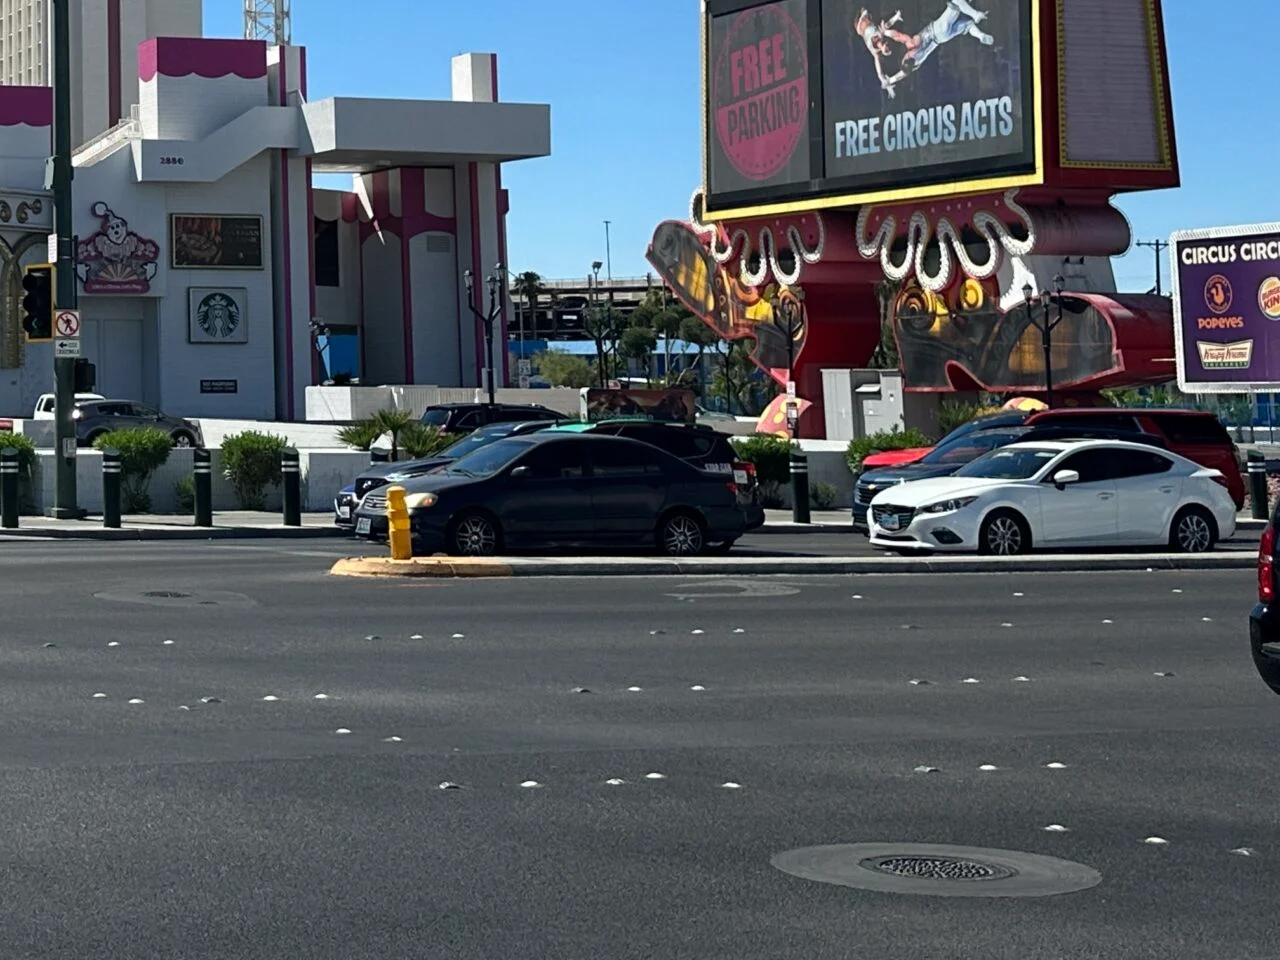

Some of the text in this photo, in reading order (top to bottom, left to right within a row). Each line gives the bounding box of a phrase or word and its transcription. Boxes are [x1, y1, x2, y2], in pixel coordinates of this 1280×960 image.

[730, 32, 786, 98] FREE
[727, 85, 800, 147] PARKING
[835, 96, 1013, 158] FREE CIRCUS ACTS
[1181, 244, 1237, 265] CIRCUS
[1263, 294, 1280, 311] KIN
